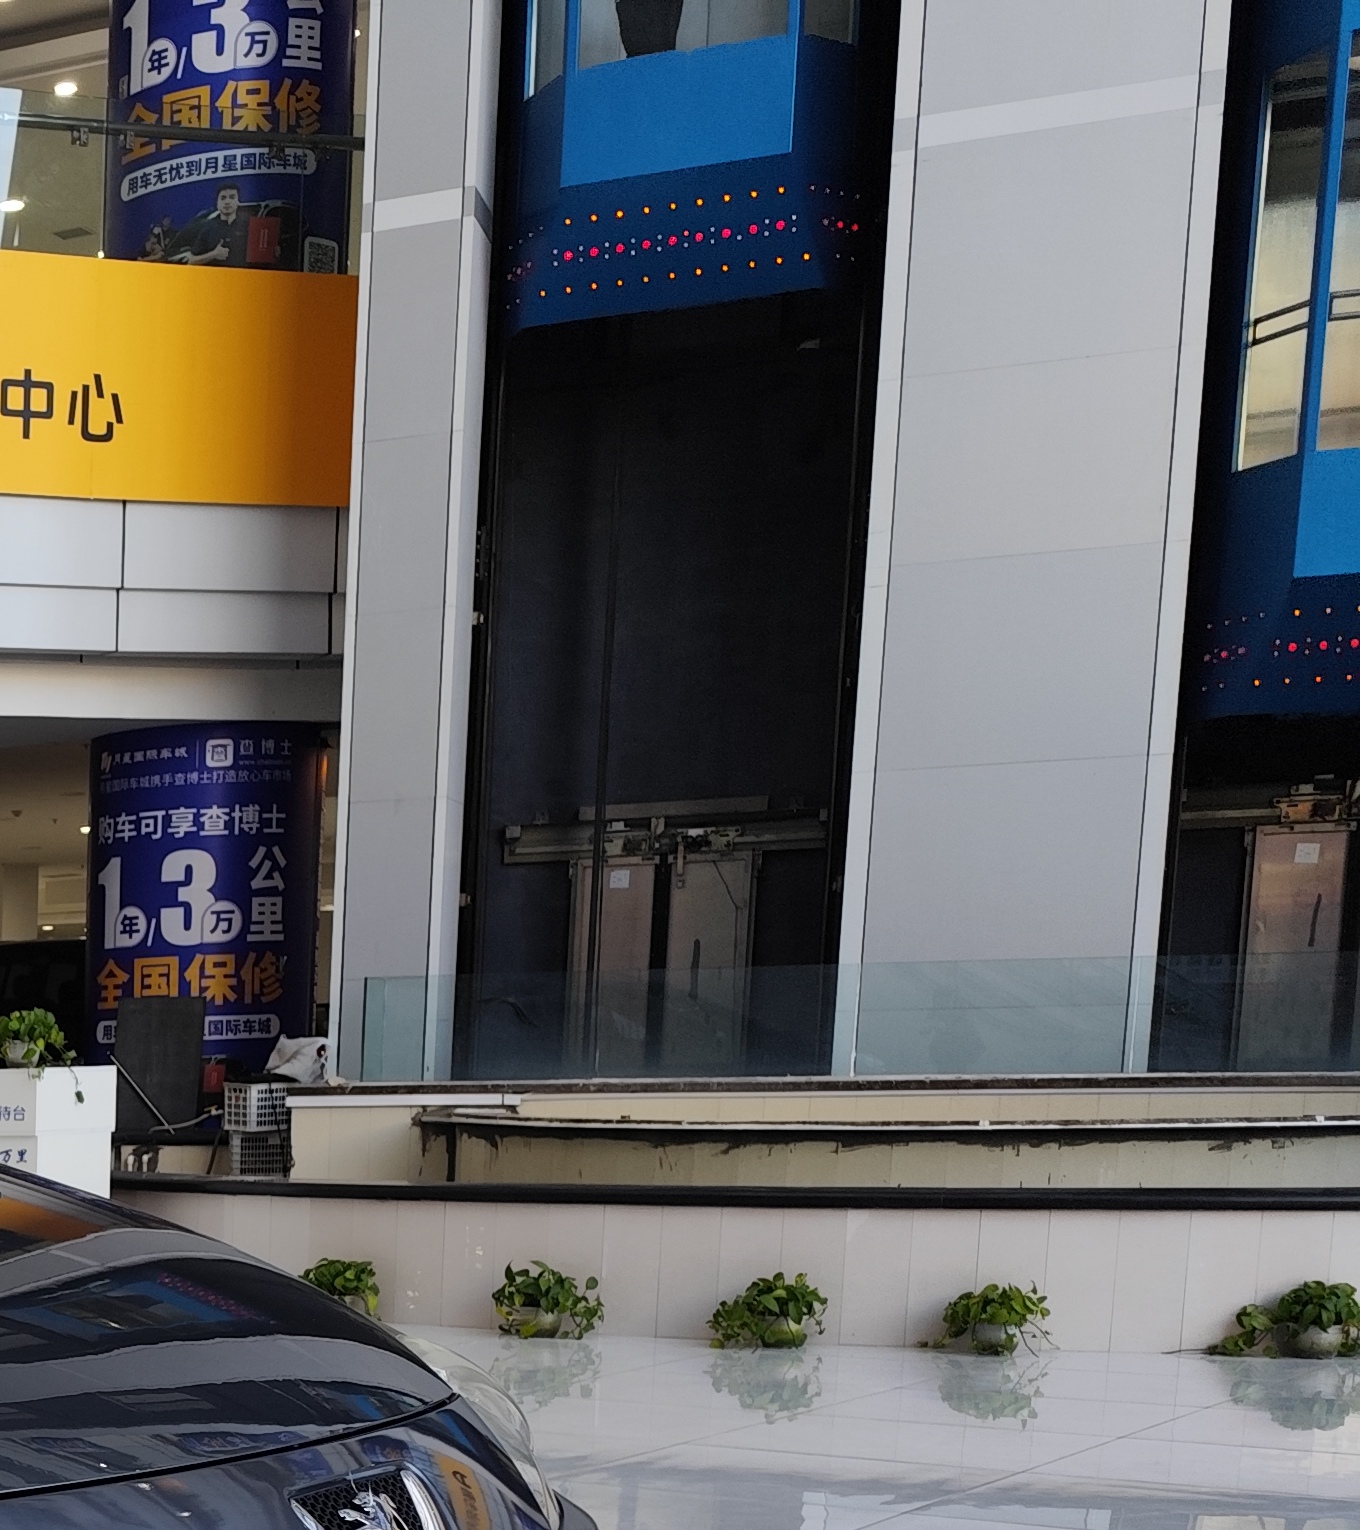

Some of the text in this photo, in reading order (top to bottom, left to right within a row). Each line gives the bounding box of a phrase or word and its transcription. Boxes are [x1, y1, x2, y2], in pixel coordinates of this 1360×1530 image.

[121, 77, 322, 165] 全国保修
[126, 152, 308, 196] 用车无忧到月星国际车城
[97, 803, 286, 845] 购车可享查博士
[96, 951, 285, 1010] 全国保修
[204, 1017, 272, 1038] 国际车城
